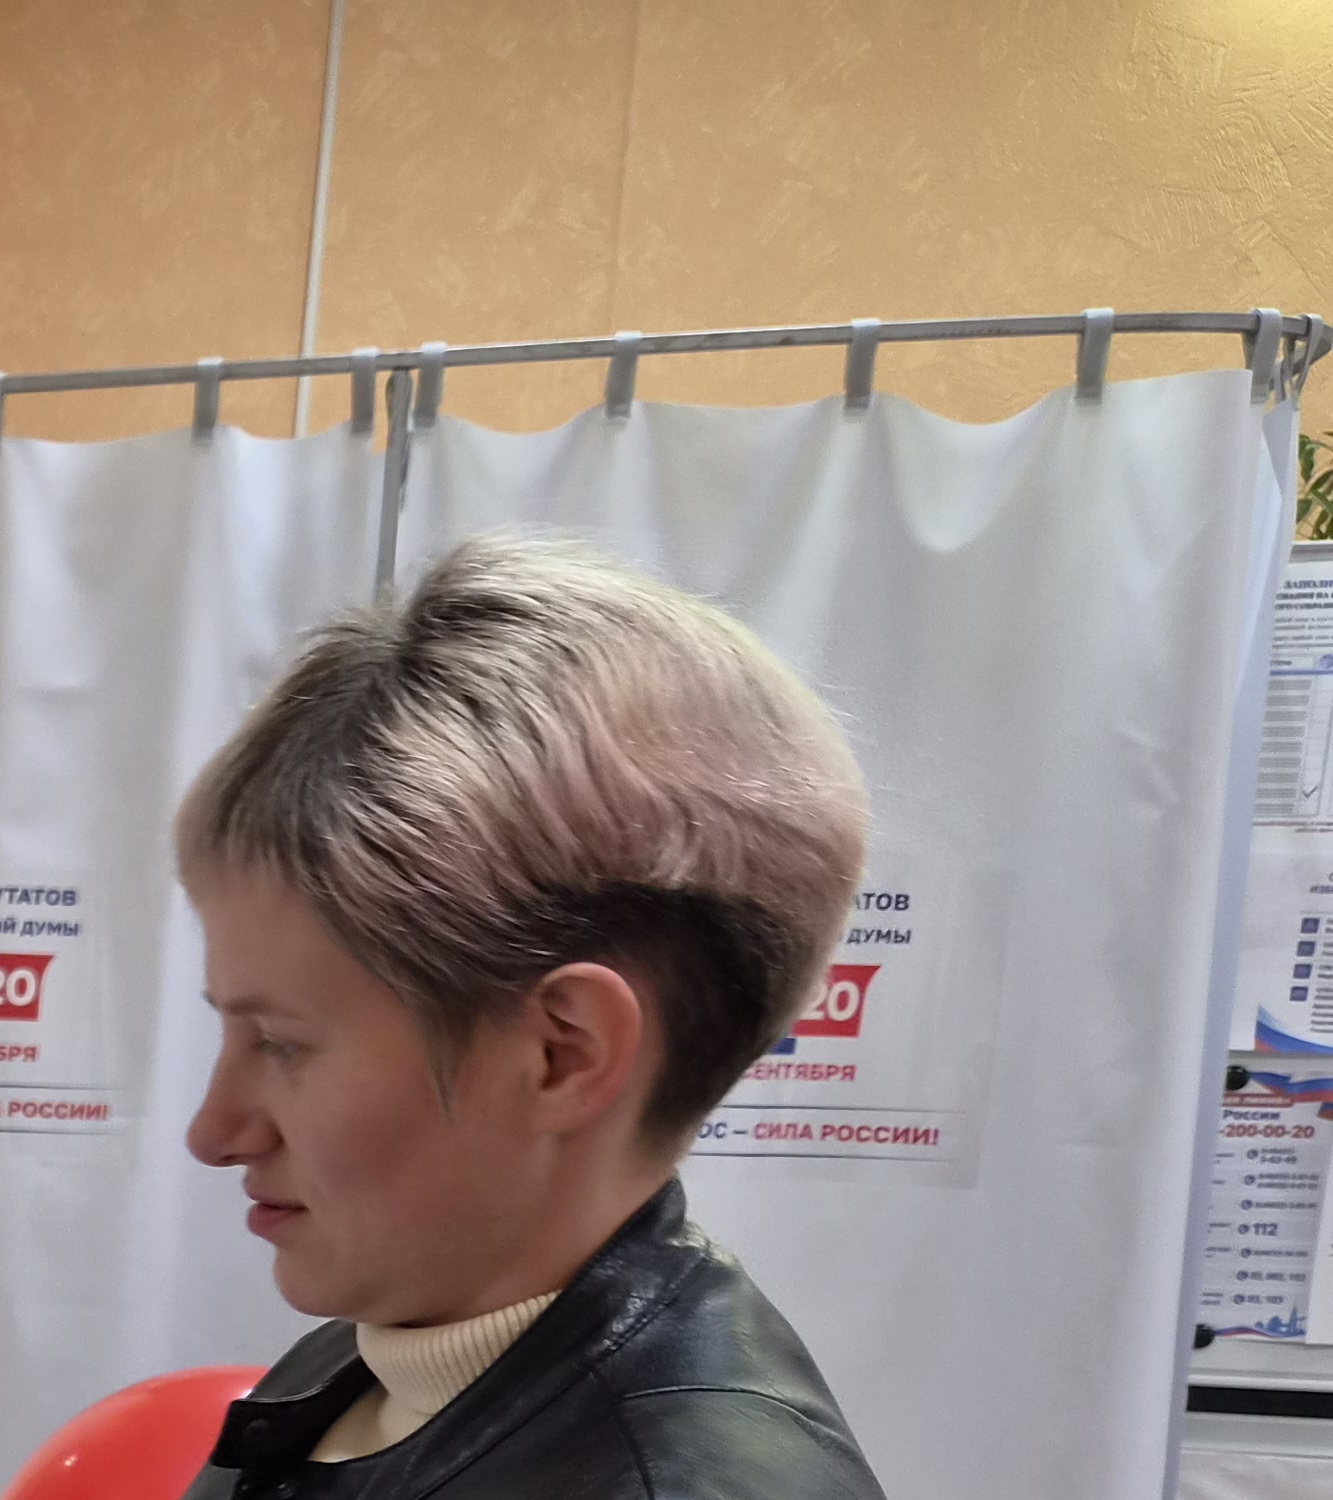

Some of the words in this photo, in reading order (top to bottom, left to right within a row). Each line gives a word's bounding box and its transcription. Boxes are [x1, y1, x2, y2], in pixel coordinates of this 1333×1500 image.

[20, 921, 79, 937] ДУМЫ
[846, 928, 911, 945] ДУМЫ
[7, 1101, 108, 1120] РОССИИ!
[754, 1122, 814, 1141] СИЛА
[820, 1125, 940, 1146] РОССИИ!
[1253, 1223, 1278, 1237] 112
